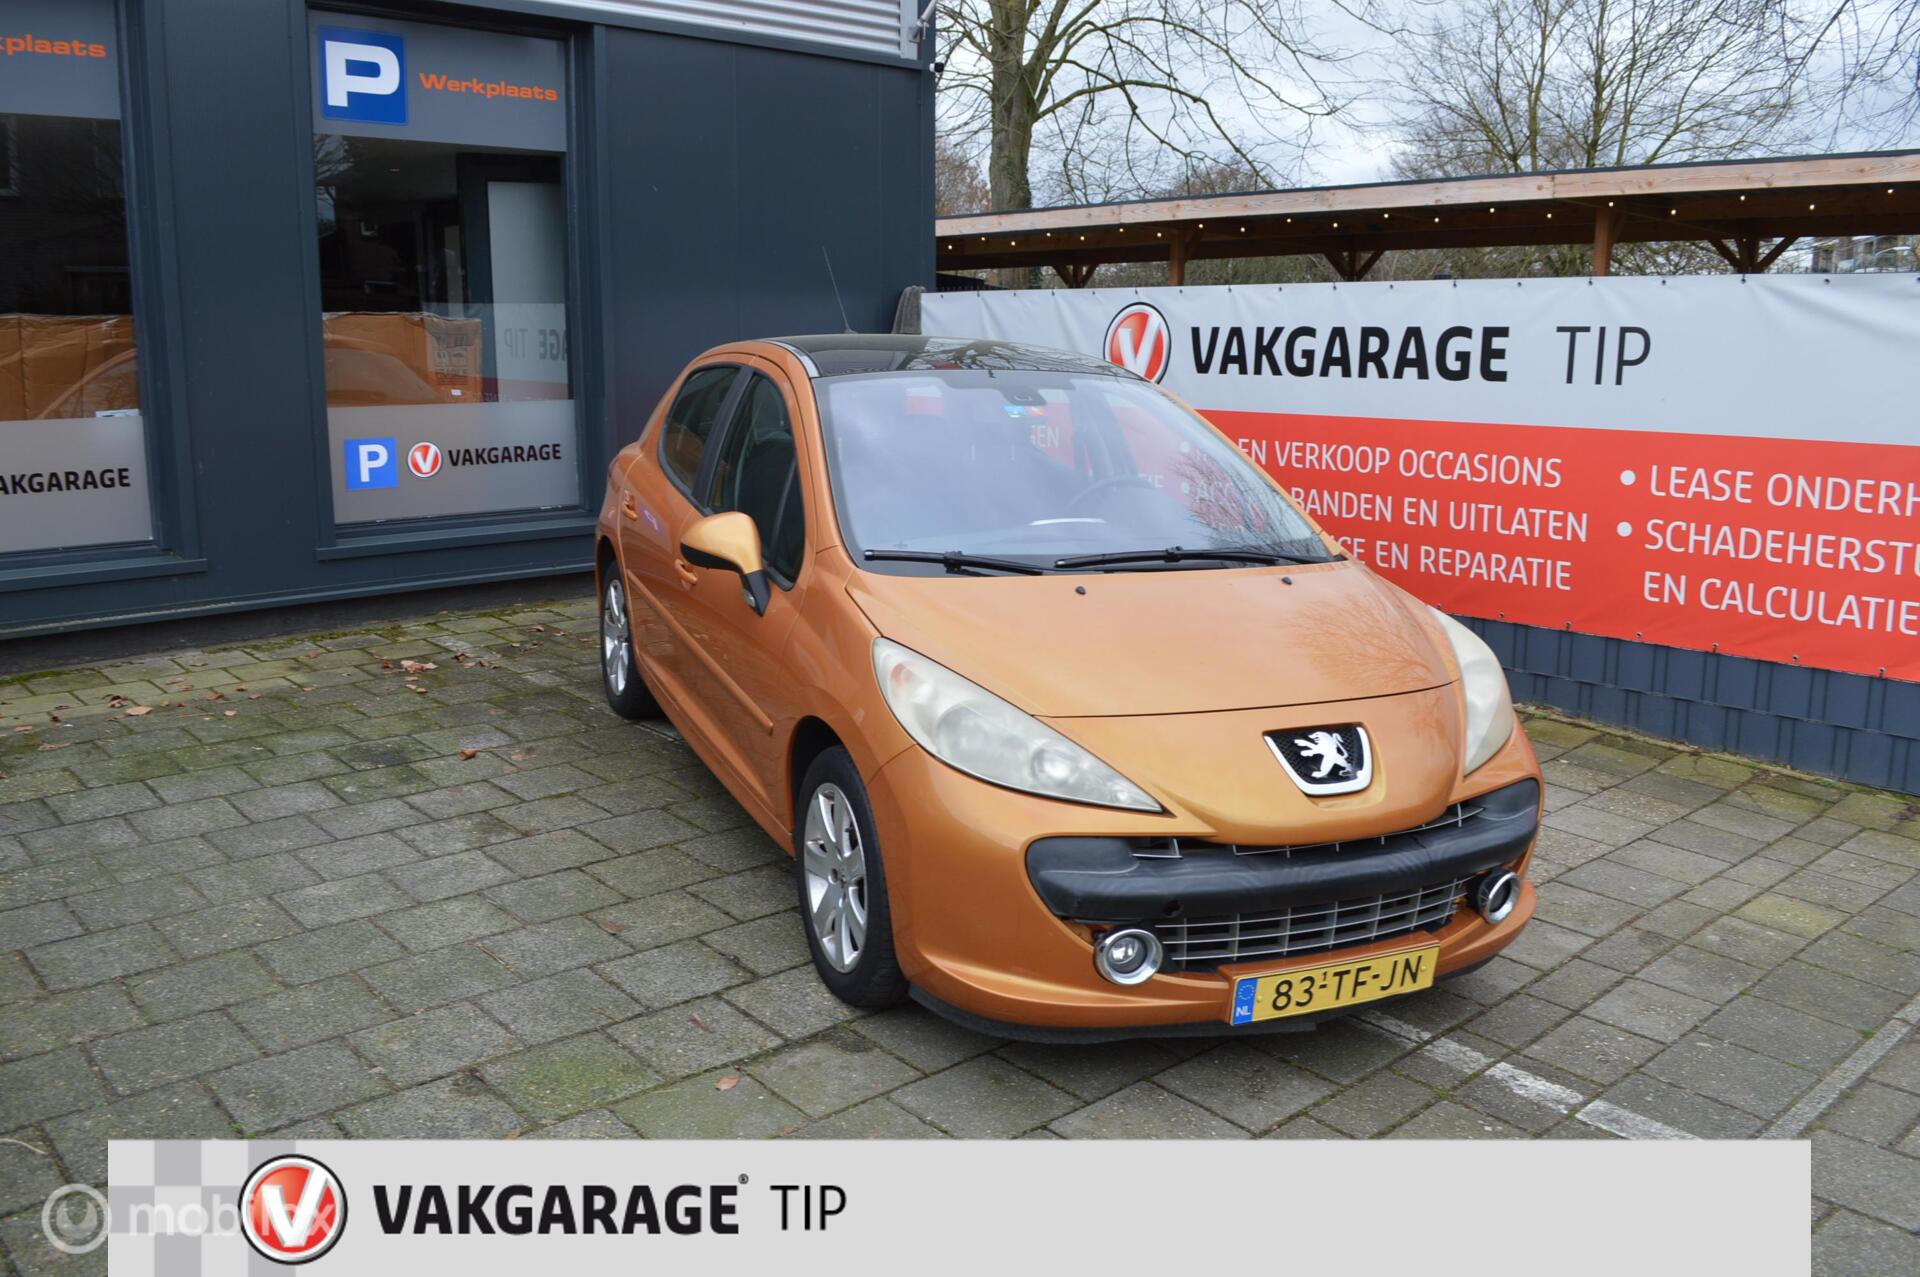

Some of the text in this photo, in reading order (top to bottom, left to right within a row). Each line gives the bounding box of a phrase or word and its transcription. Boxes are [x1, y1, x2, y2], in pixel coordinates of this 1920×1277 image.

[325, 40, 400, 107] P
[419, 72, 558, 101] Werkplaats
[1190, 325, 1651, 386] VAKGARAGE TIP
[358, 443, 389, 483] P
[448, 443, 562, 467] VAKGARAGE
[1275, 440, 1390, 474] VERKOOP
[1398, 448, 1562, 488] OCCASIONS
[1649, 464, 1754, 504] LEASE
[1290, 486, 1587, 543] BANDEN EN UITLATEN
[1374, 539, 1409, 571] EN
[1418, 545, 1572, 591] REPARATIE
[1643, 570, 1920, 636] EN CALCULATIE
[1235, 955, 1423, 1017] NL 83-TF-JN
